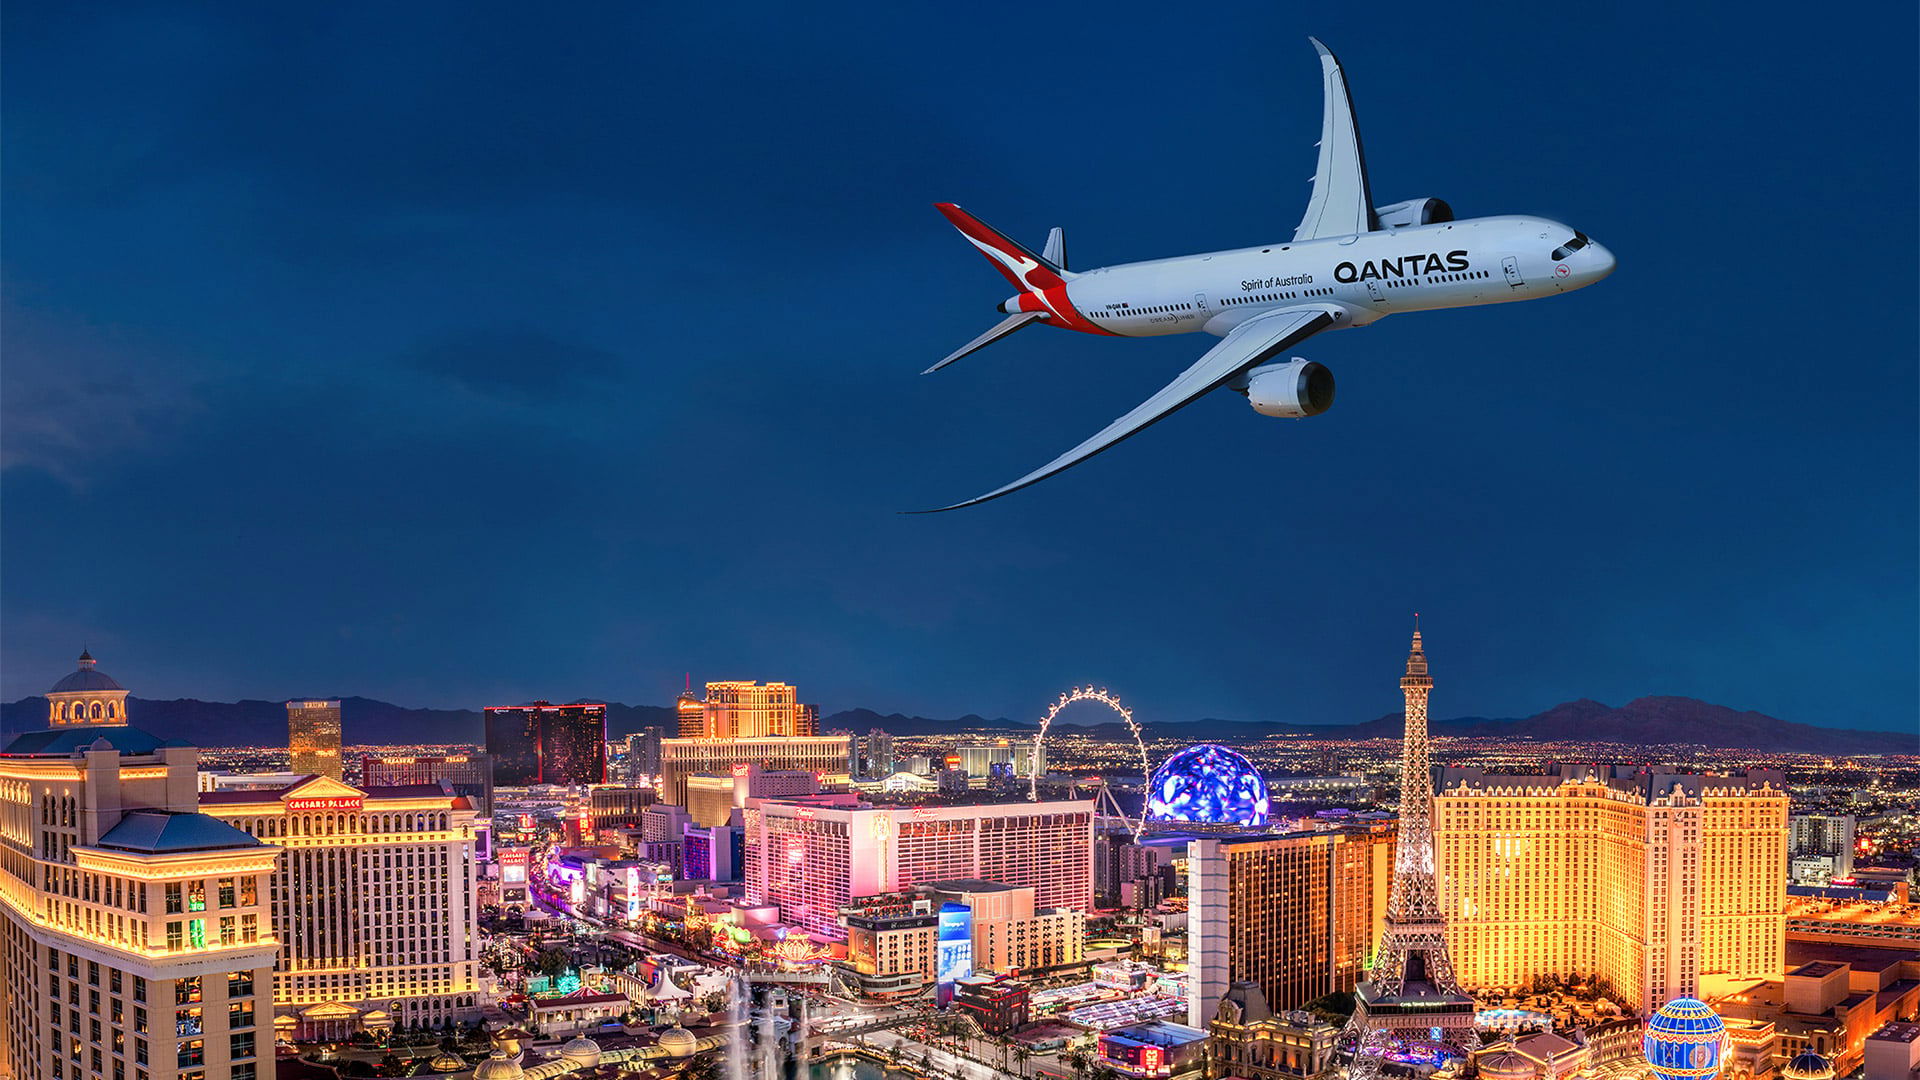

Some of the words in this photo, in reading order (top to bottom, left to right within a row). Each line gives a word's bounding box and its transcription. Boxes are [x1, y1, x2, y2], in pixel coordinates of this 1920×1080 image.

[1334, 250, 1470, 284] QANTAS
[1241, 279, 1262, 292] Spirit
[1265, 278, 1273, 288] of
[1275, 274, 1313, 287] Australia
[289, 800, 326, 809] CAESARS
[328, 799, 360, 808] PALACE
